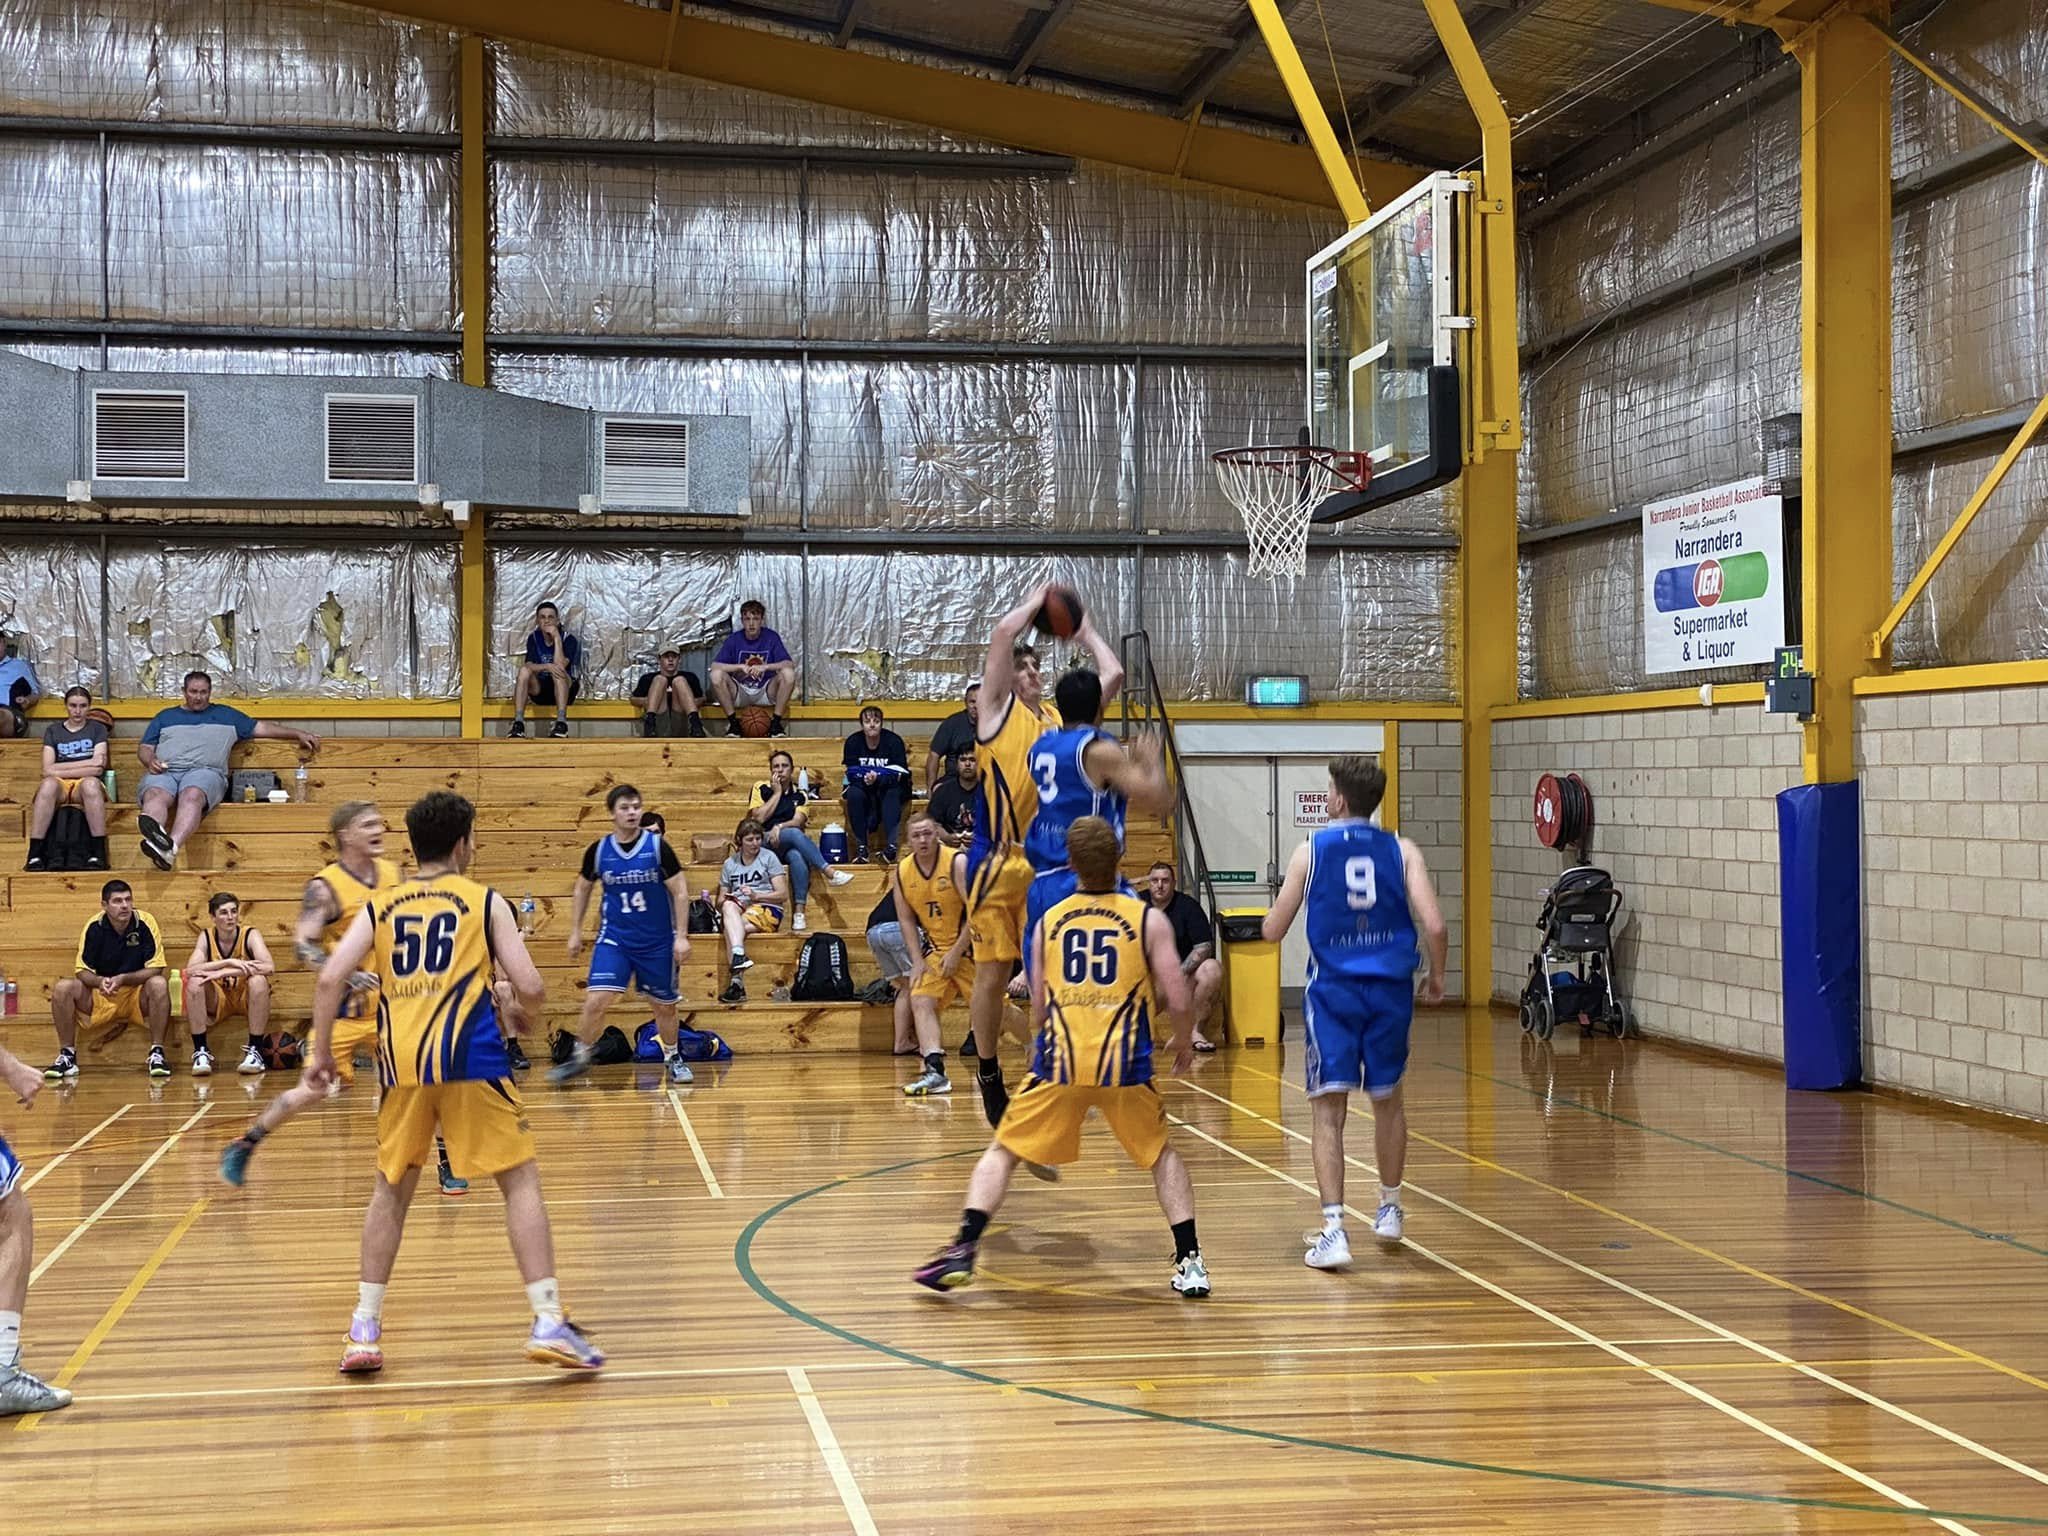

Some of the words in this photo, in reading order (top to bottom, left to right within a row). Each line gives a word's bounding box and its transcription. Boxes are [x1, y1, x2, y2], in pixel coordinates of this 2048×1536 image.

[1649, 507, 1681, 524] Narrandera
[1682, 502, 1700, 517] Junior
[1701, 490, 1734, 514] Basketball
[1734, 483, 1768, 504] Associat
[1679, 518, 1701, 533] Proudly
[1675, 530, 1743, 560] Narrandera
[1697, 566, 1720, 598] IGA
[1673, 607, 1749, 639] Supermarket
[1682, 641, 1691, 662] &
[1697, 640, 1736, 664] Liquor
[1780, 651, 1799, 679] 24
[1034, 752, 1059, 805] 3
[1298, 793, 1329, 803] EMERG
[1302, 804, 1321, 814] EXIT
[601, 868, 659, 886] Griffith
[730, 870, 763, 890] FILA
[1344, 855, 1377, 911] 9
[620, 891, 648, 914] 14
[391, 910, 459, 979] 56
[1062, 927, 1120, 987] 65
